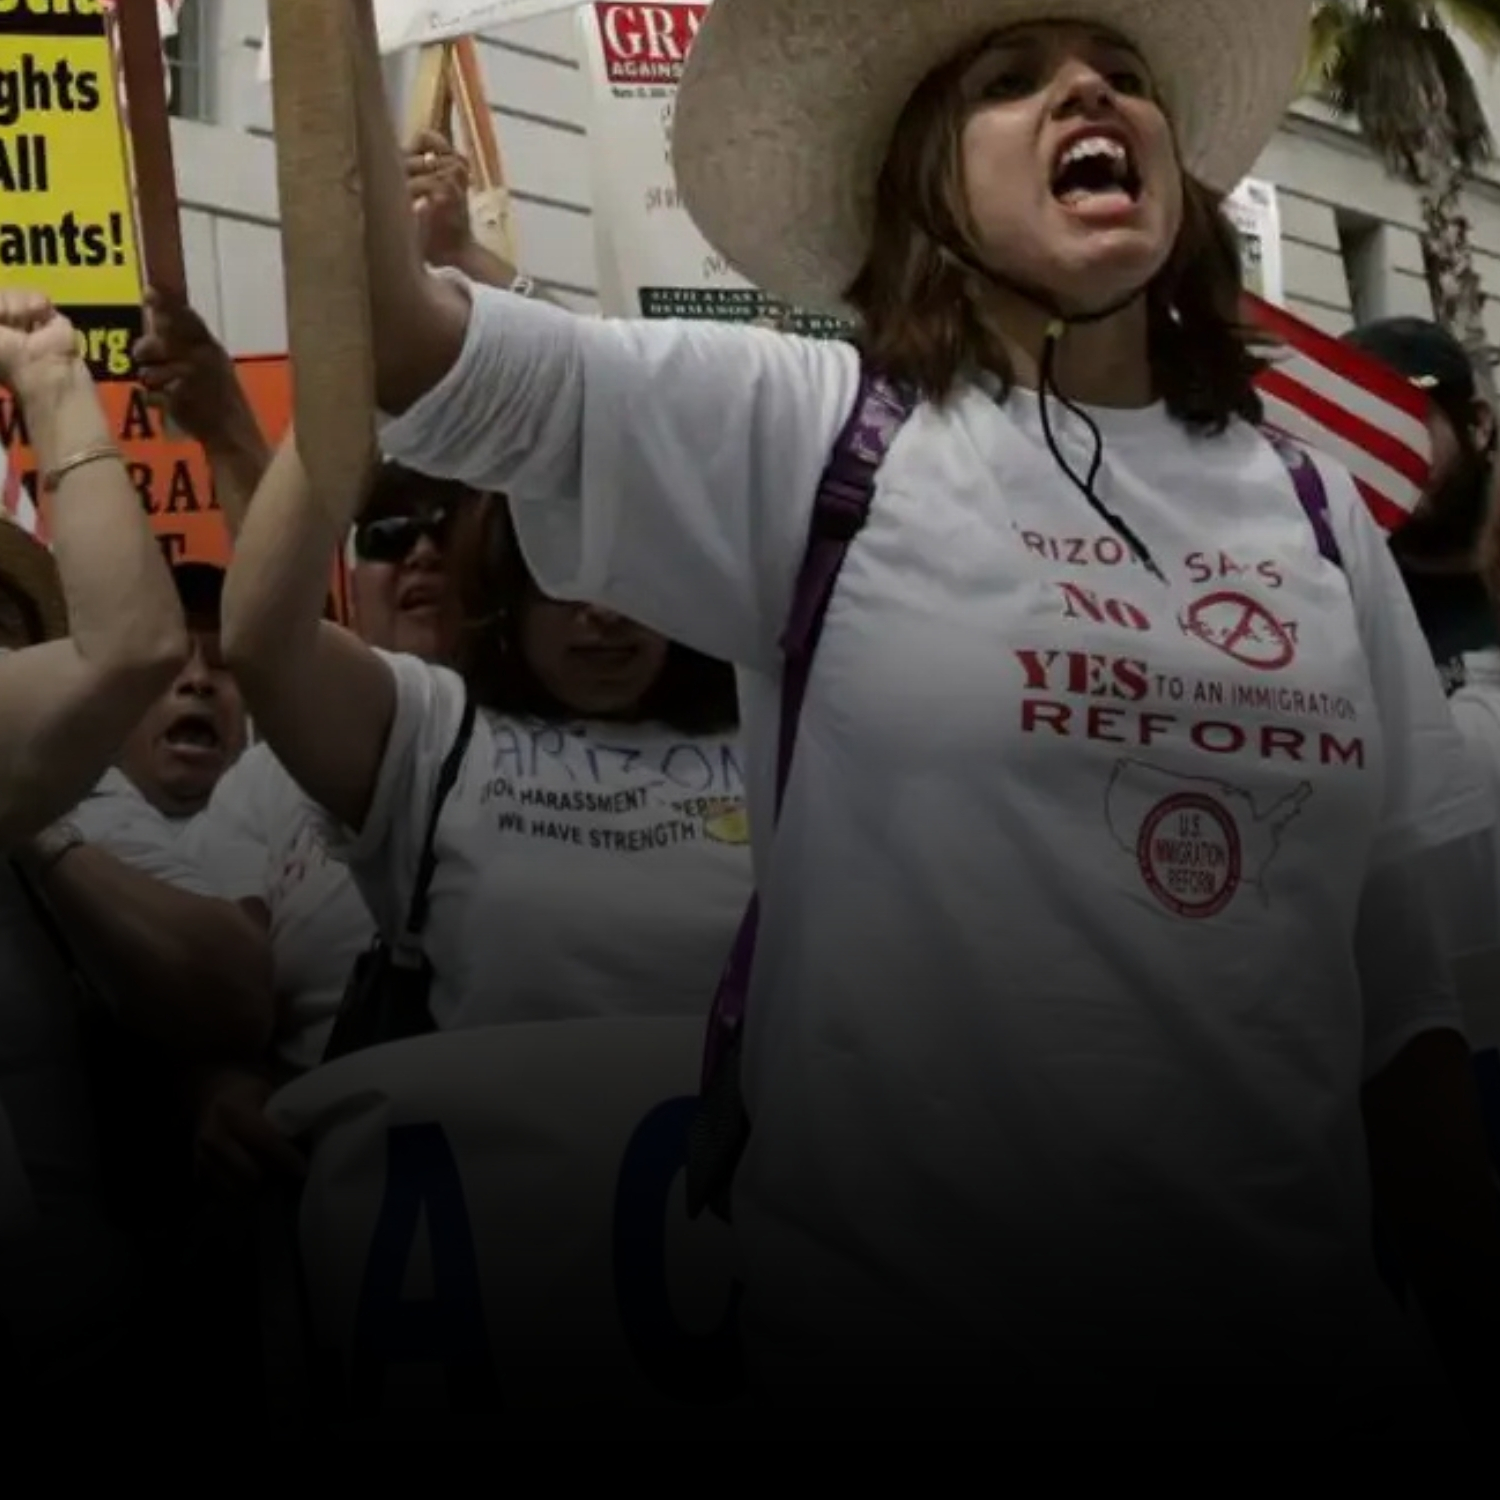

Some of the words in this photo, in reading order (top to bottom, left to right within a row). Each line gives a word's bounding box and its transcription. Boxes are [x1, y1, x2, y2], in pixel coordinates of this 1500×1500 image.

[1015, 650, 1148, 701] YES
[1154, 674, 1184, 701] TO
[1193, 681, 1225, 703] AN
[1230, 684, 1356, 722] IMMIGRATION
[1020, 699, 1365, 770] REFORM
[521, 788, 647, 813] HARASSMENT
[499, 813, 525, 833] WE
[531, 820, 582, 845] HAVE
[589, 821, 696, 851] STRENGTH
